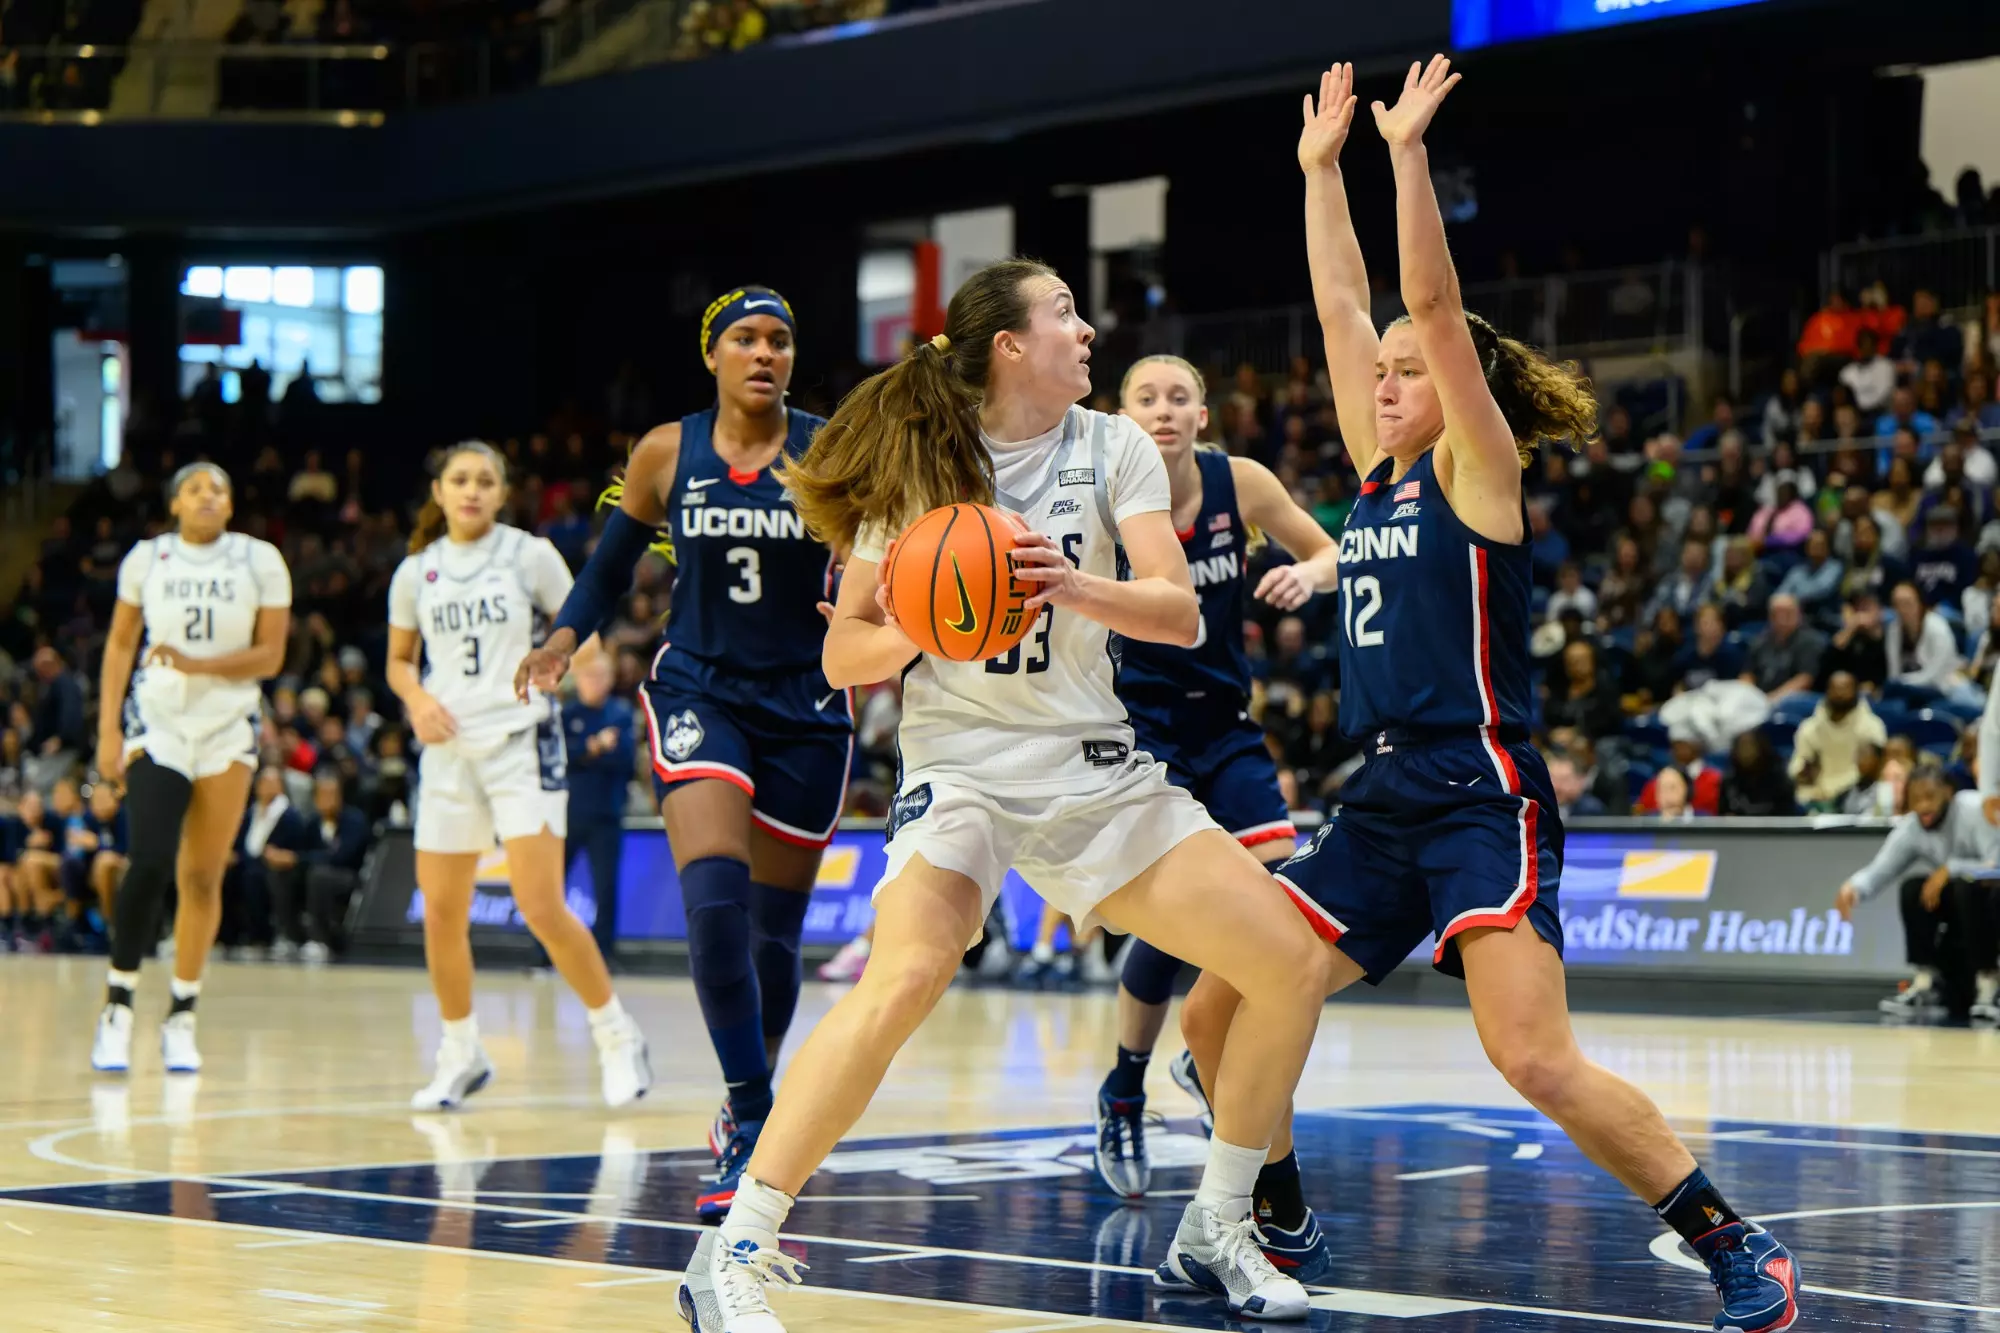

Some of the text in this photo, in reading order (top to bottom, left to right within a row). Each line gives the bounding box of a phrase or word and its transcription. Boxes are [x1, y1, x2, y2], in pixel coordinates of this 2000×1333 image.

[1050, 504, 1081, 514] EAST
[1053, 499, 1074, 508] BIG
[1395, 507, 1421, 515] EAST
[1399, 501, 1417, 509] BIG
[681, 507, 804, 540] UCONN
[1339, 524, 1418, 564] CONN
[163, 578, 236, 603] HOYAS
[726, 546, 762, 604] 3
[185, 606, 213, 640] 21
[431, 594, 509, 634] HOYAS
[1342, 574, 1384, 649] 12
[462, 636, 481, 676] 3
[1559, 904, 1854, 955] edStar Health
